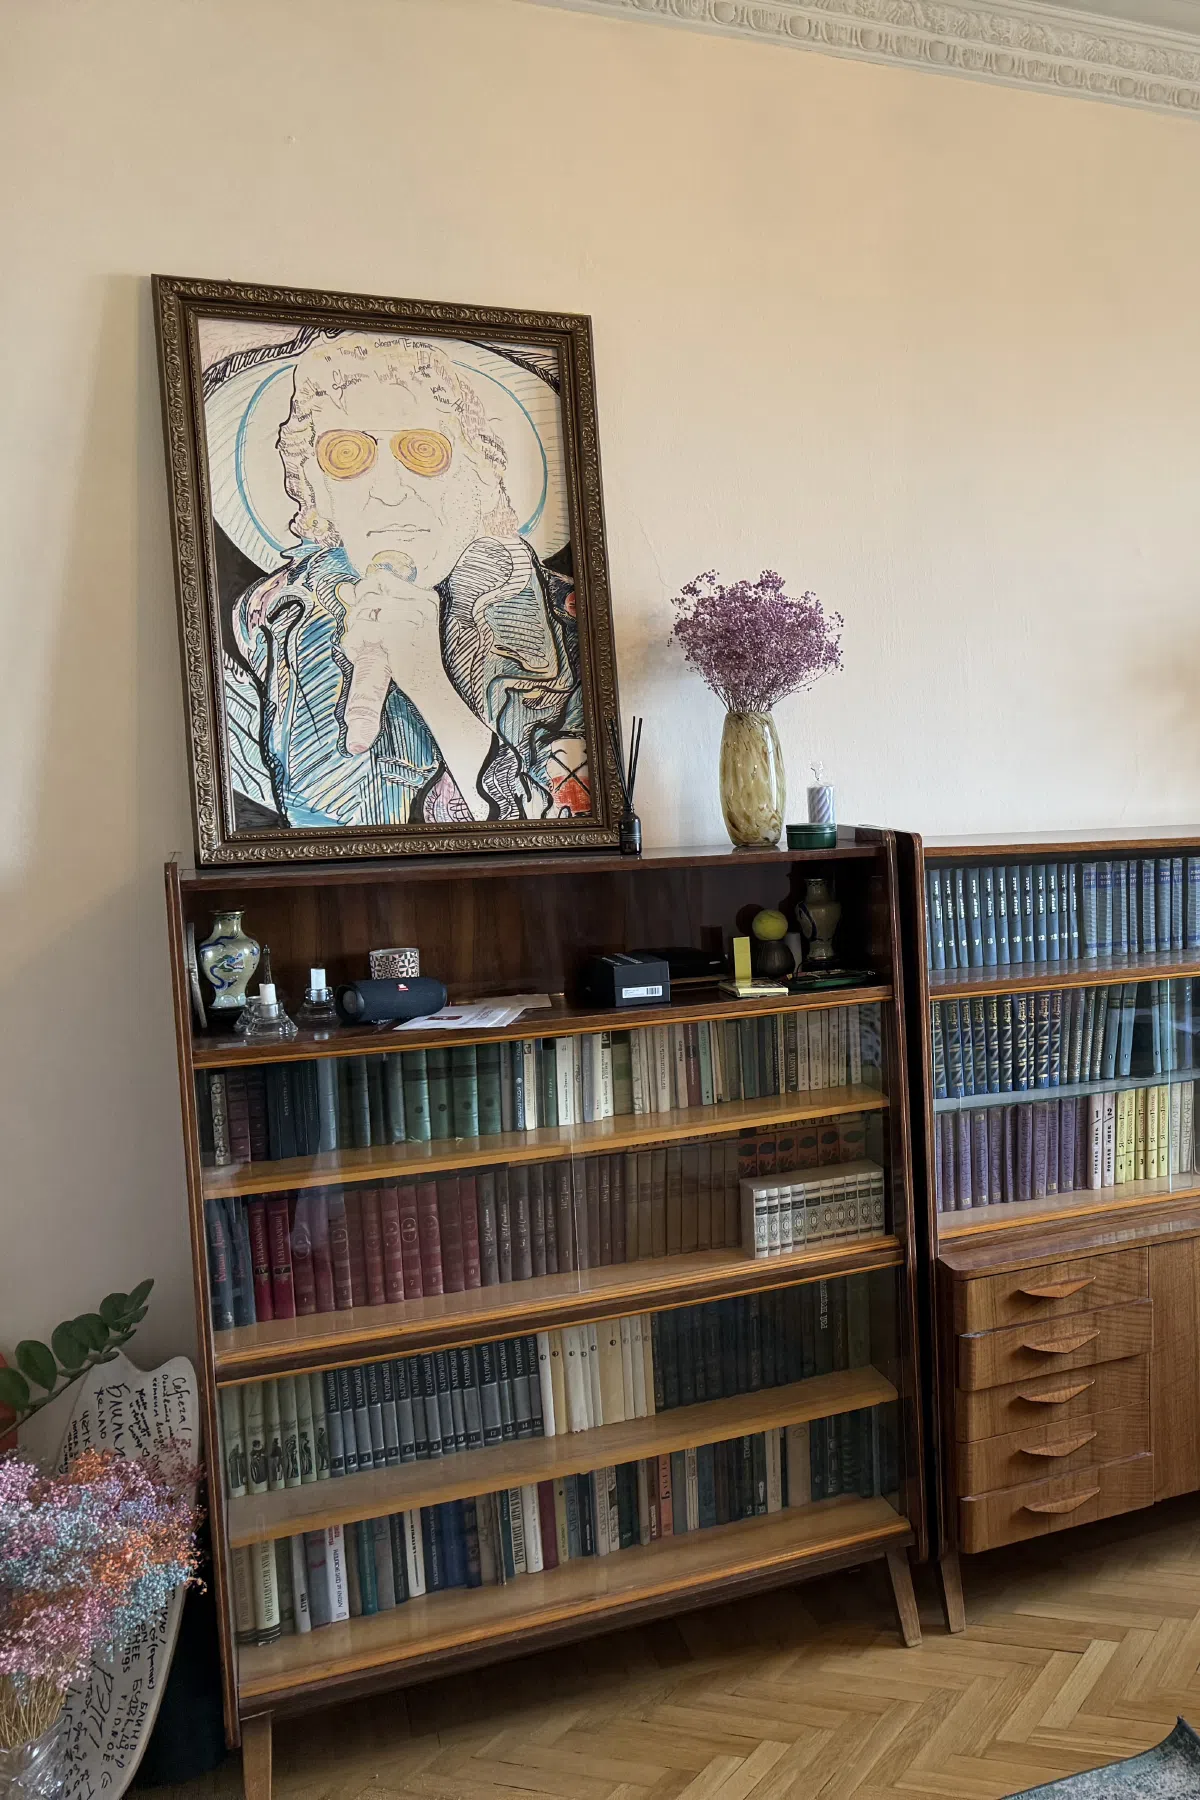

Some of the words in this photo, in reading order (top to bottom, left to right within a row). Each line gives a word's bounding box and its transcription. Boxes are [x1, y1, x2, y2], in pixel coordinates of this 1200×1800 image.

[1107, 1107, 1113, 1116] 2
[1127, 1159, 1133, 1167] 2
[1149, 1157, 1156, 1165] 4
[1160, 1155, 1166, 1163] 5
[505, 1425, 514, 1434] 13
[520, 1421, 530, 1430] 14
[488, 1429, 498, 1438] 12
[445, 1437, 452, 1446] 9
[456, 1434, 465, 1443] 10
[469, 1434, 477, 1443] 11
[390, 1448, 397, 1457] 5
[404, 1445, 412, 1454] 6
[334, 1456, 340, 1465] 1
[347, 1455, 355, 1465] 2
[362, 1453, 369, 1462] 3
